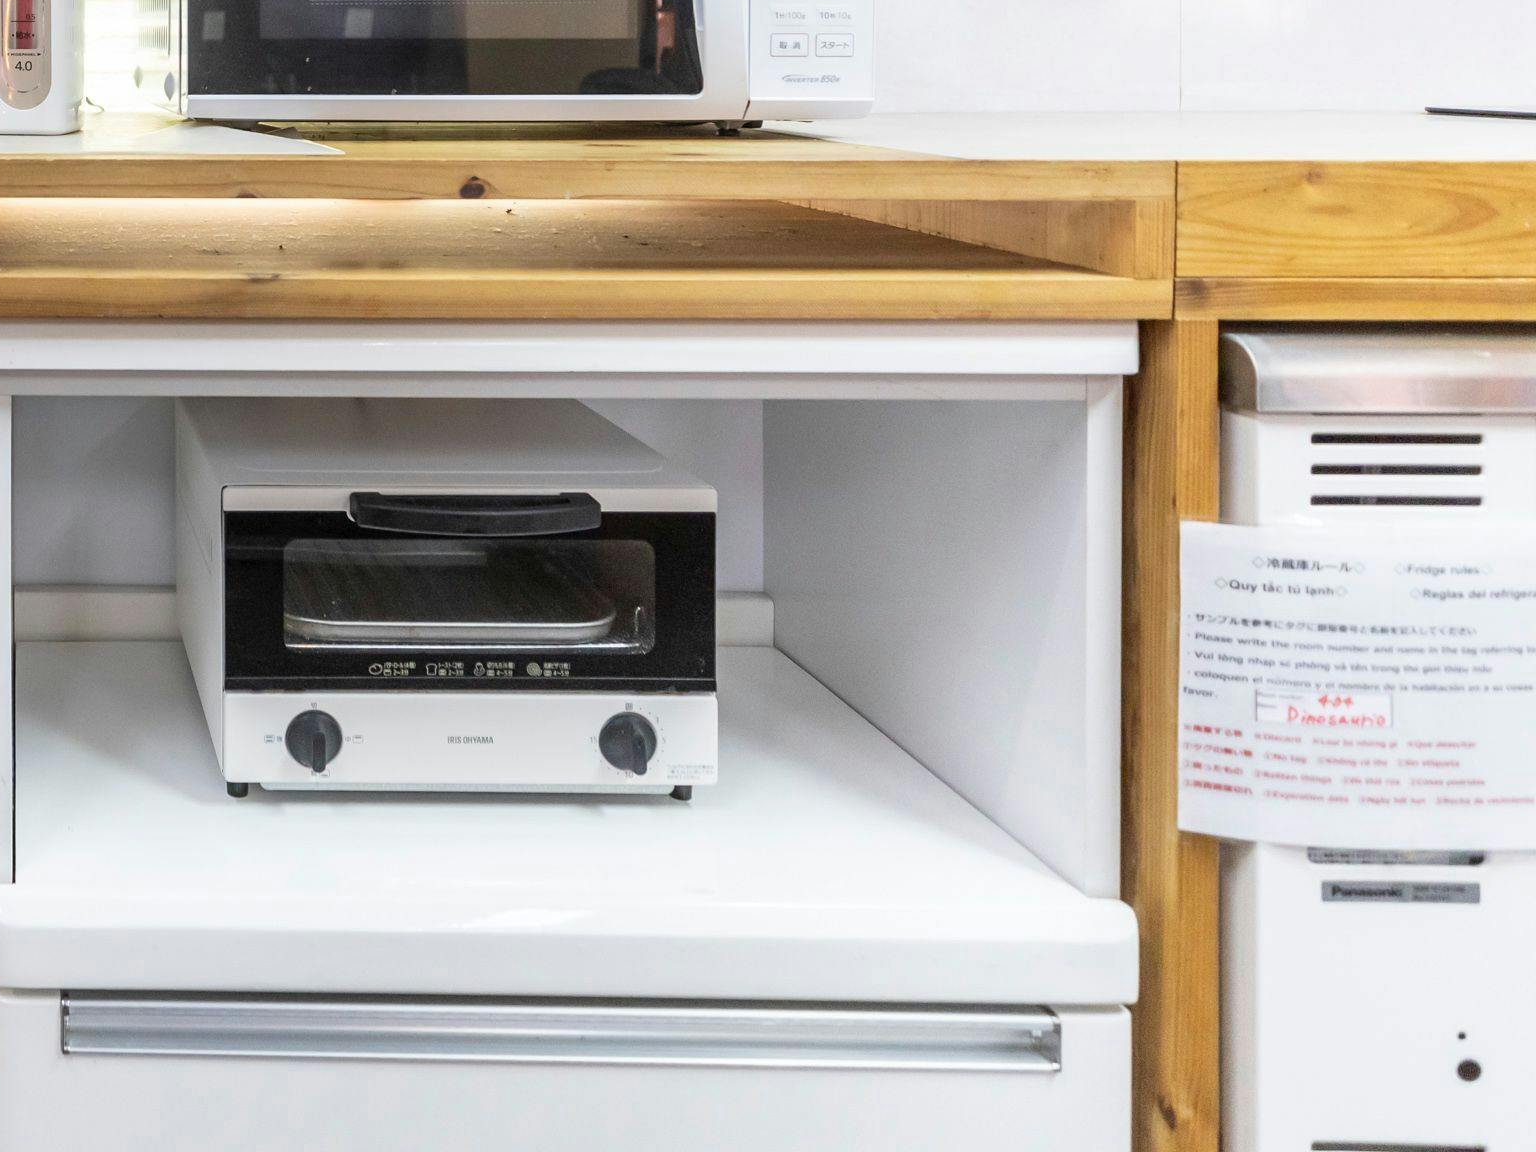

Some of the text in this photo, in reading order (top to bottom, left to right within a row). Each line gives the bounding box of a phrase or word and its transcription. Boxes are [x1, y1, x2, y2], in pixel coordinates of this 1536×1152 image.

[14, 60, 33, 71] 4.0
[1229, 579, 1257, 594] Quy
[1195, 632, 1234, 644] Please
[463, 735, 495, 745] OHYAMA
